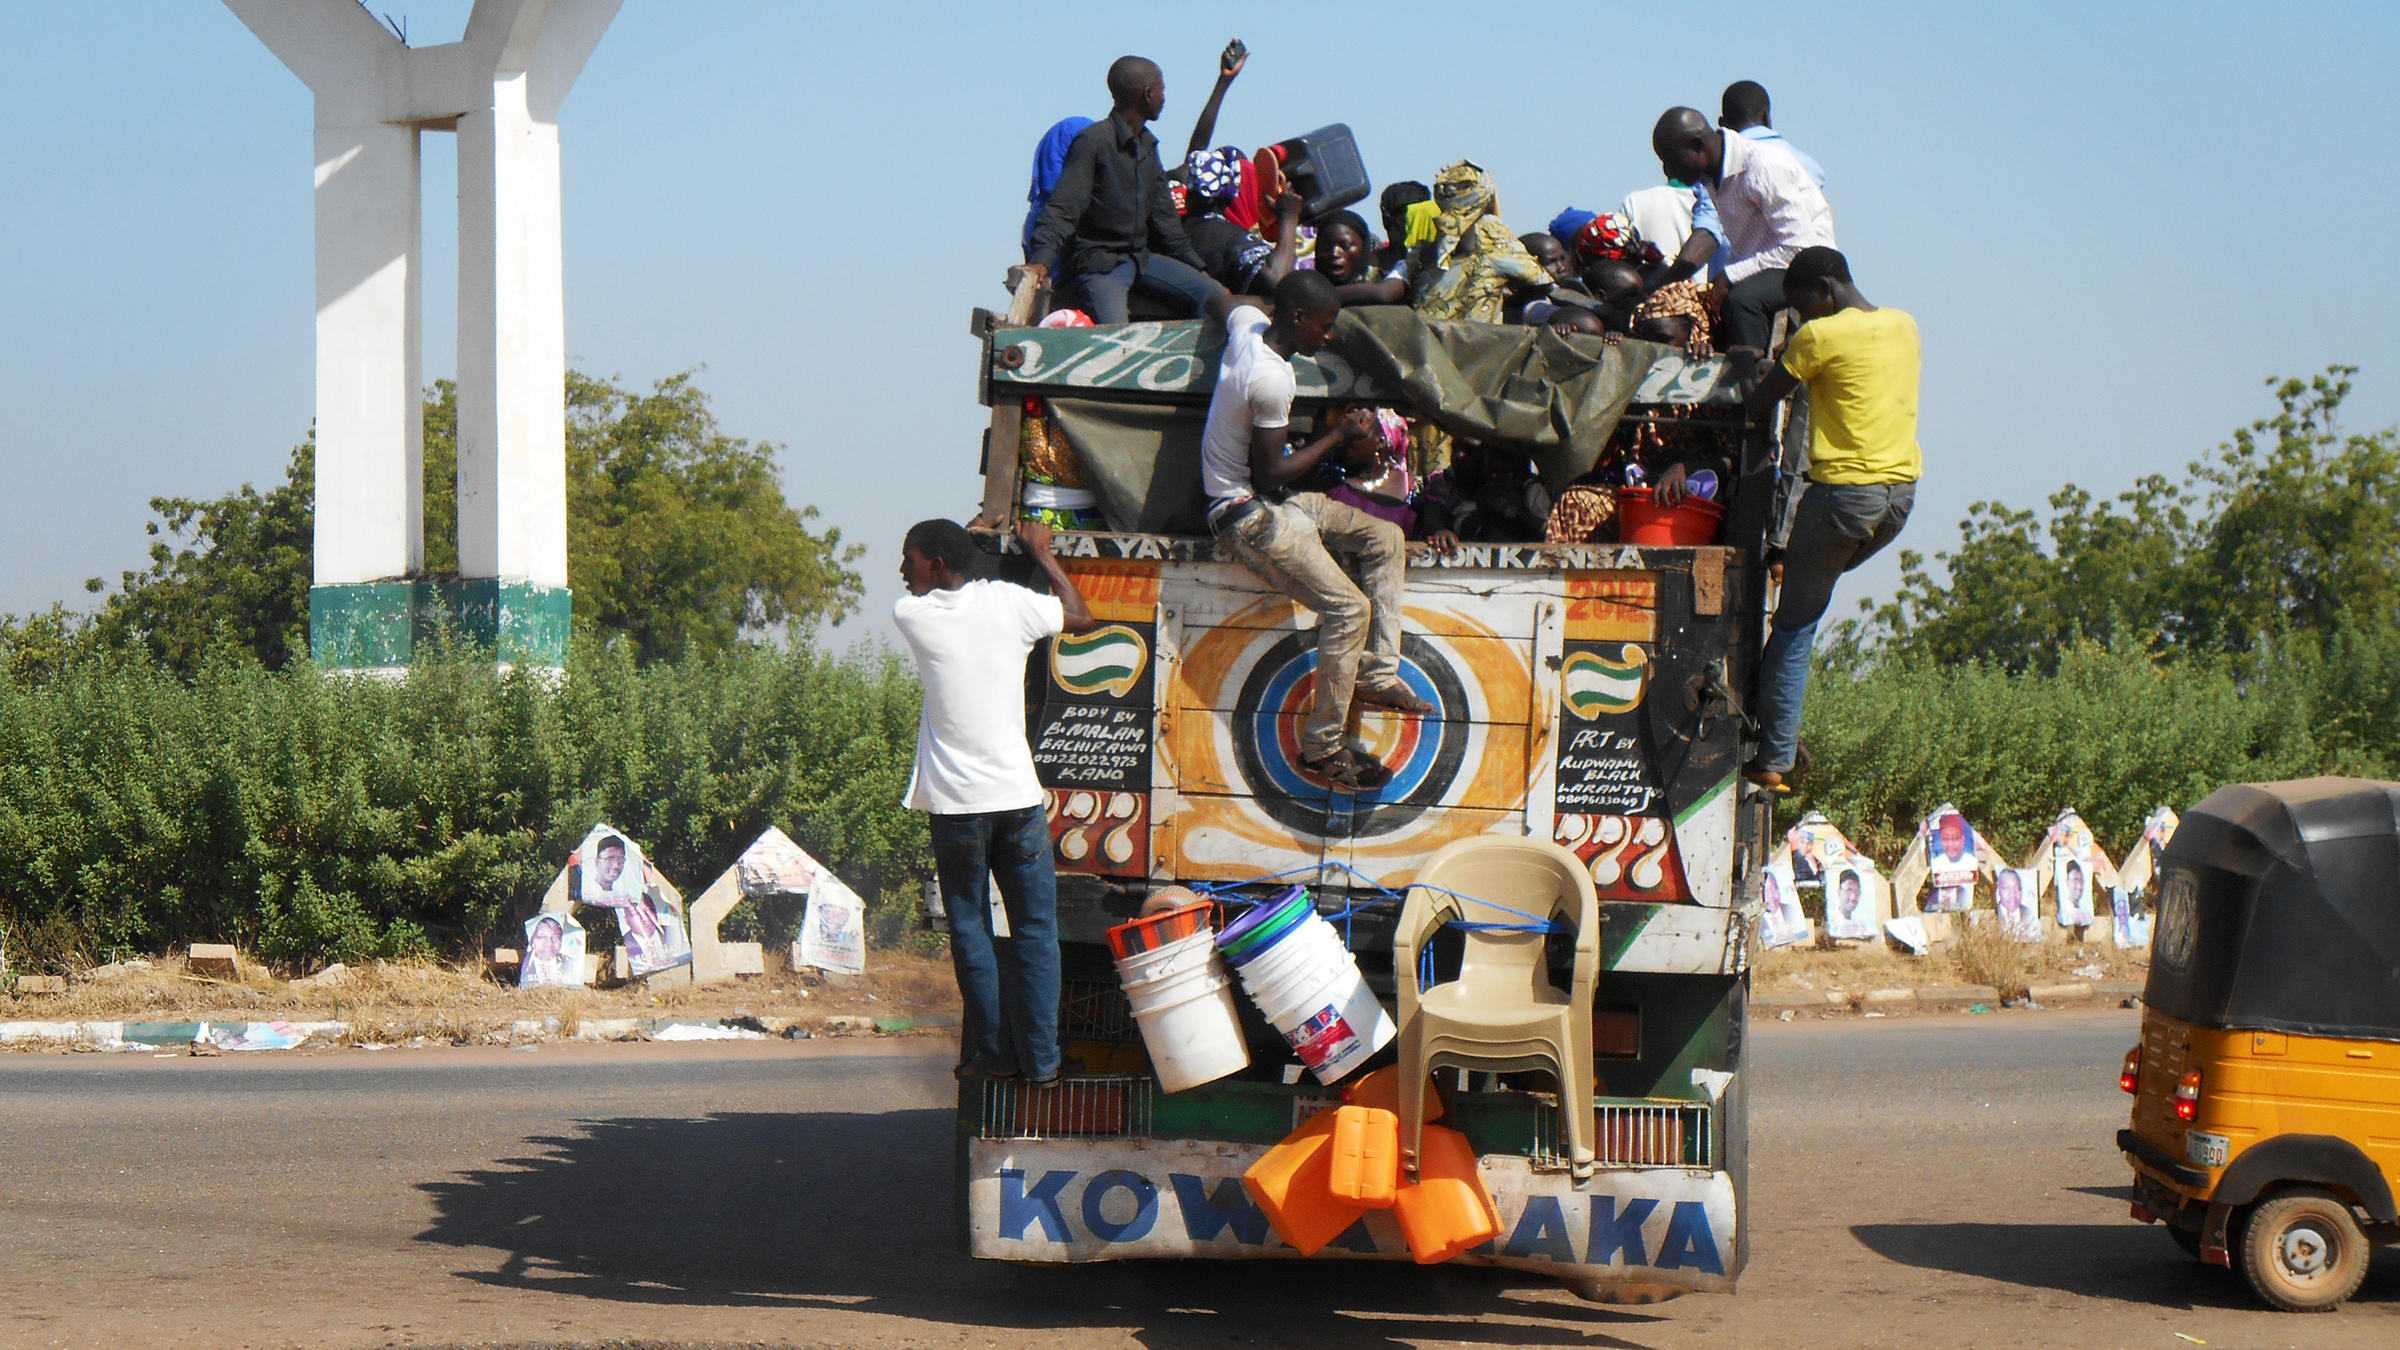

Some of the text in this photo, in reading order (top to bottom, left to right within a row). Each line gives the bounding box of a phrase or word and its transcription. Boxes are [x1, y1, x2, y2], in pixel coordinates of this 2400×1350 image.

[1566, 578, 1650, 623] 2012
[1062, 706, 1137, 723] BODY BY
[1569, 729, 1638, 752] ART BY
[1057, 767, 1126, 781] KANO
[1407, 1193, 1727, 1276] AKA
